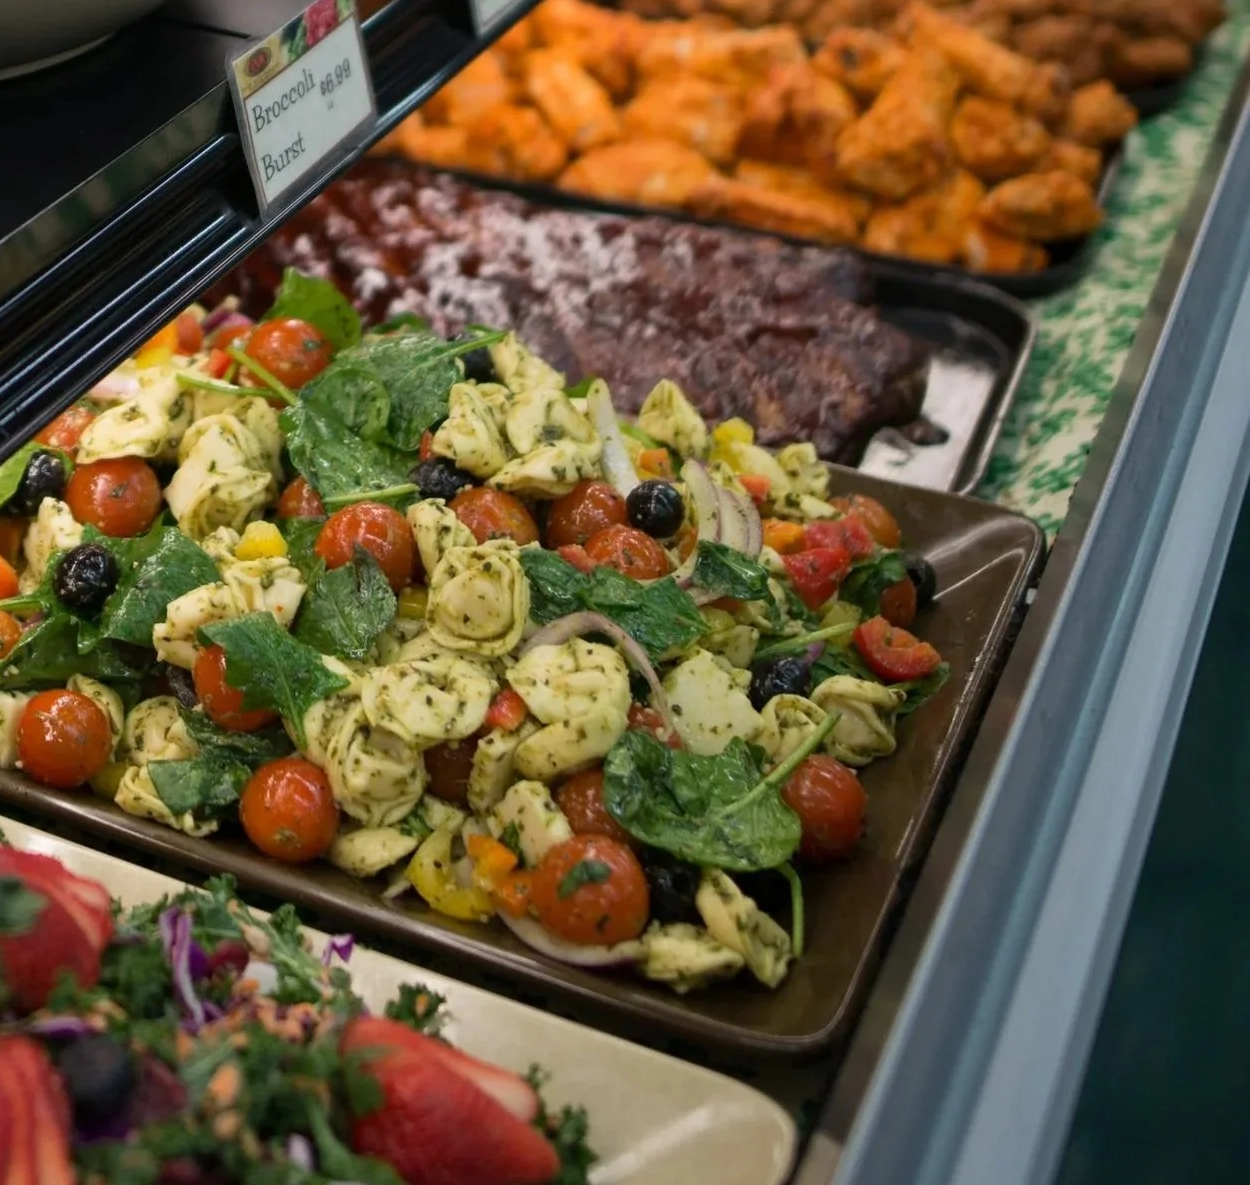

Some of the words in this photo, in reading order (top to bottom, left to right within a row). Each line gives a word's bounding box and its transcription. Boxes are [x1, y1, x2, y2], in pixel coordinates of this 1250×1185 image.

[252, 68, 316, 133] Broccoli
[320, 57, 352, 96] $6.99
[261, 131, 306, 183] Burst
